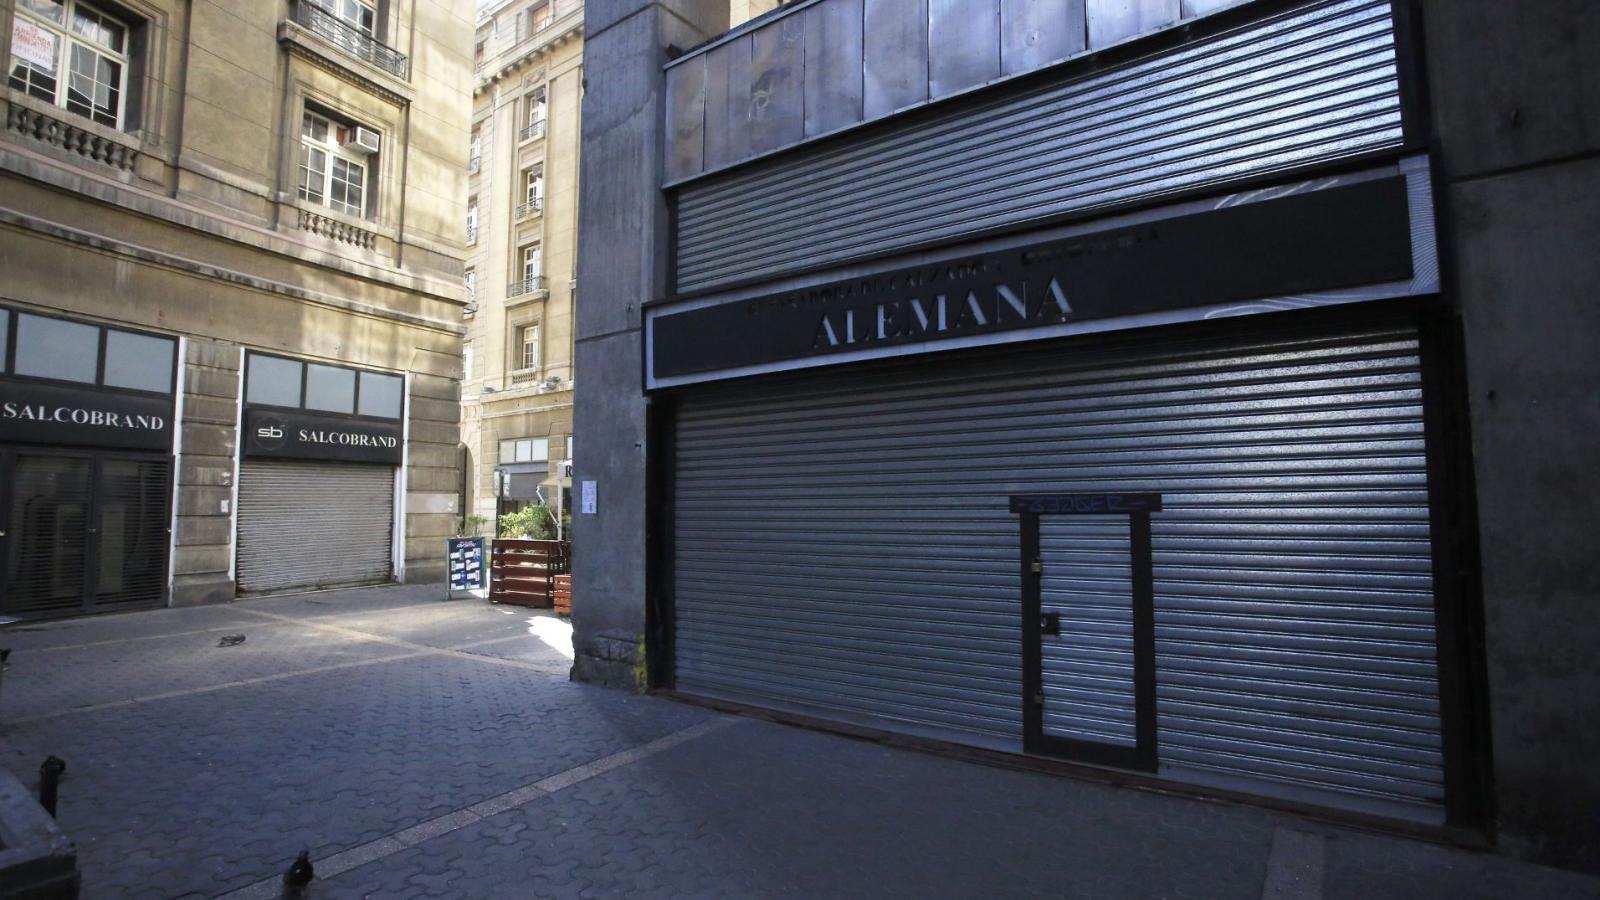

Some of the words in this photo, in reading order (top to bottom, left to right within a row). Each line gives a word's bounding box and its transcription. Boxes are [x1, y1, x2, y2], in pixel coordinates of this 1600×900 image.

[811, 273, 1074, 349] ALEMANA
[3, 402, 164, 430] SALCOBRAND
[257, 425, 283, 438] sb
[299, 429, 397, 448] SALCOBRAND
